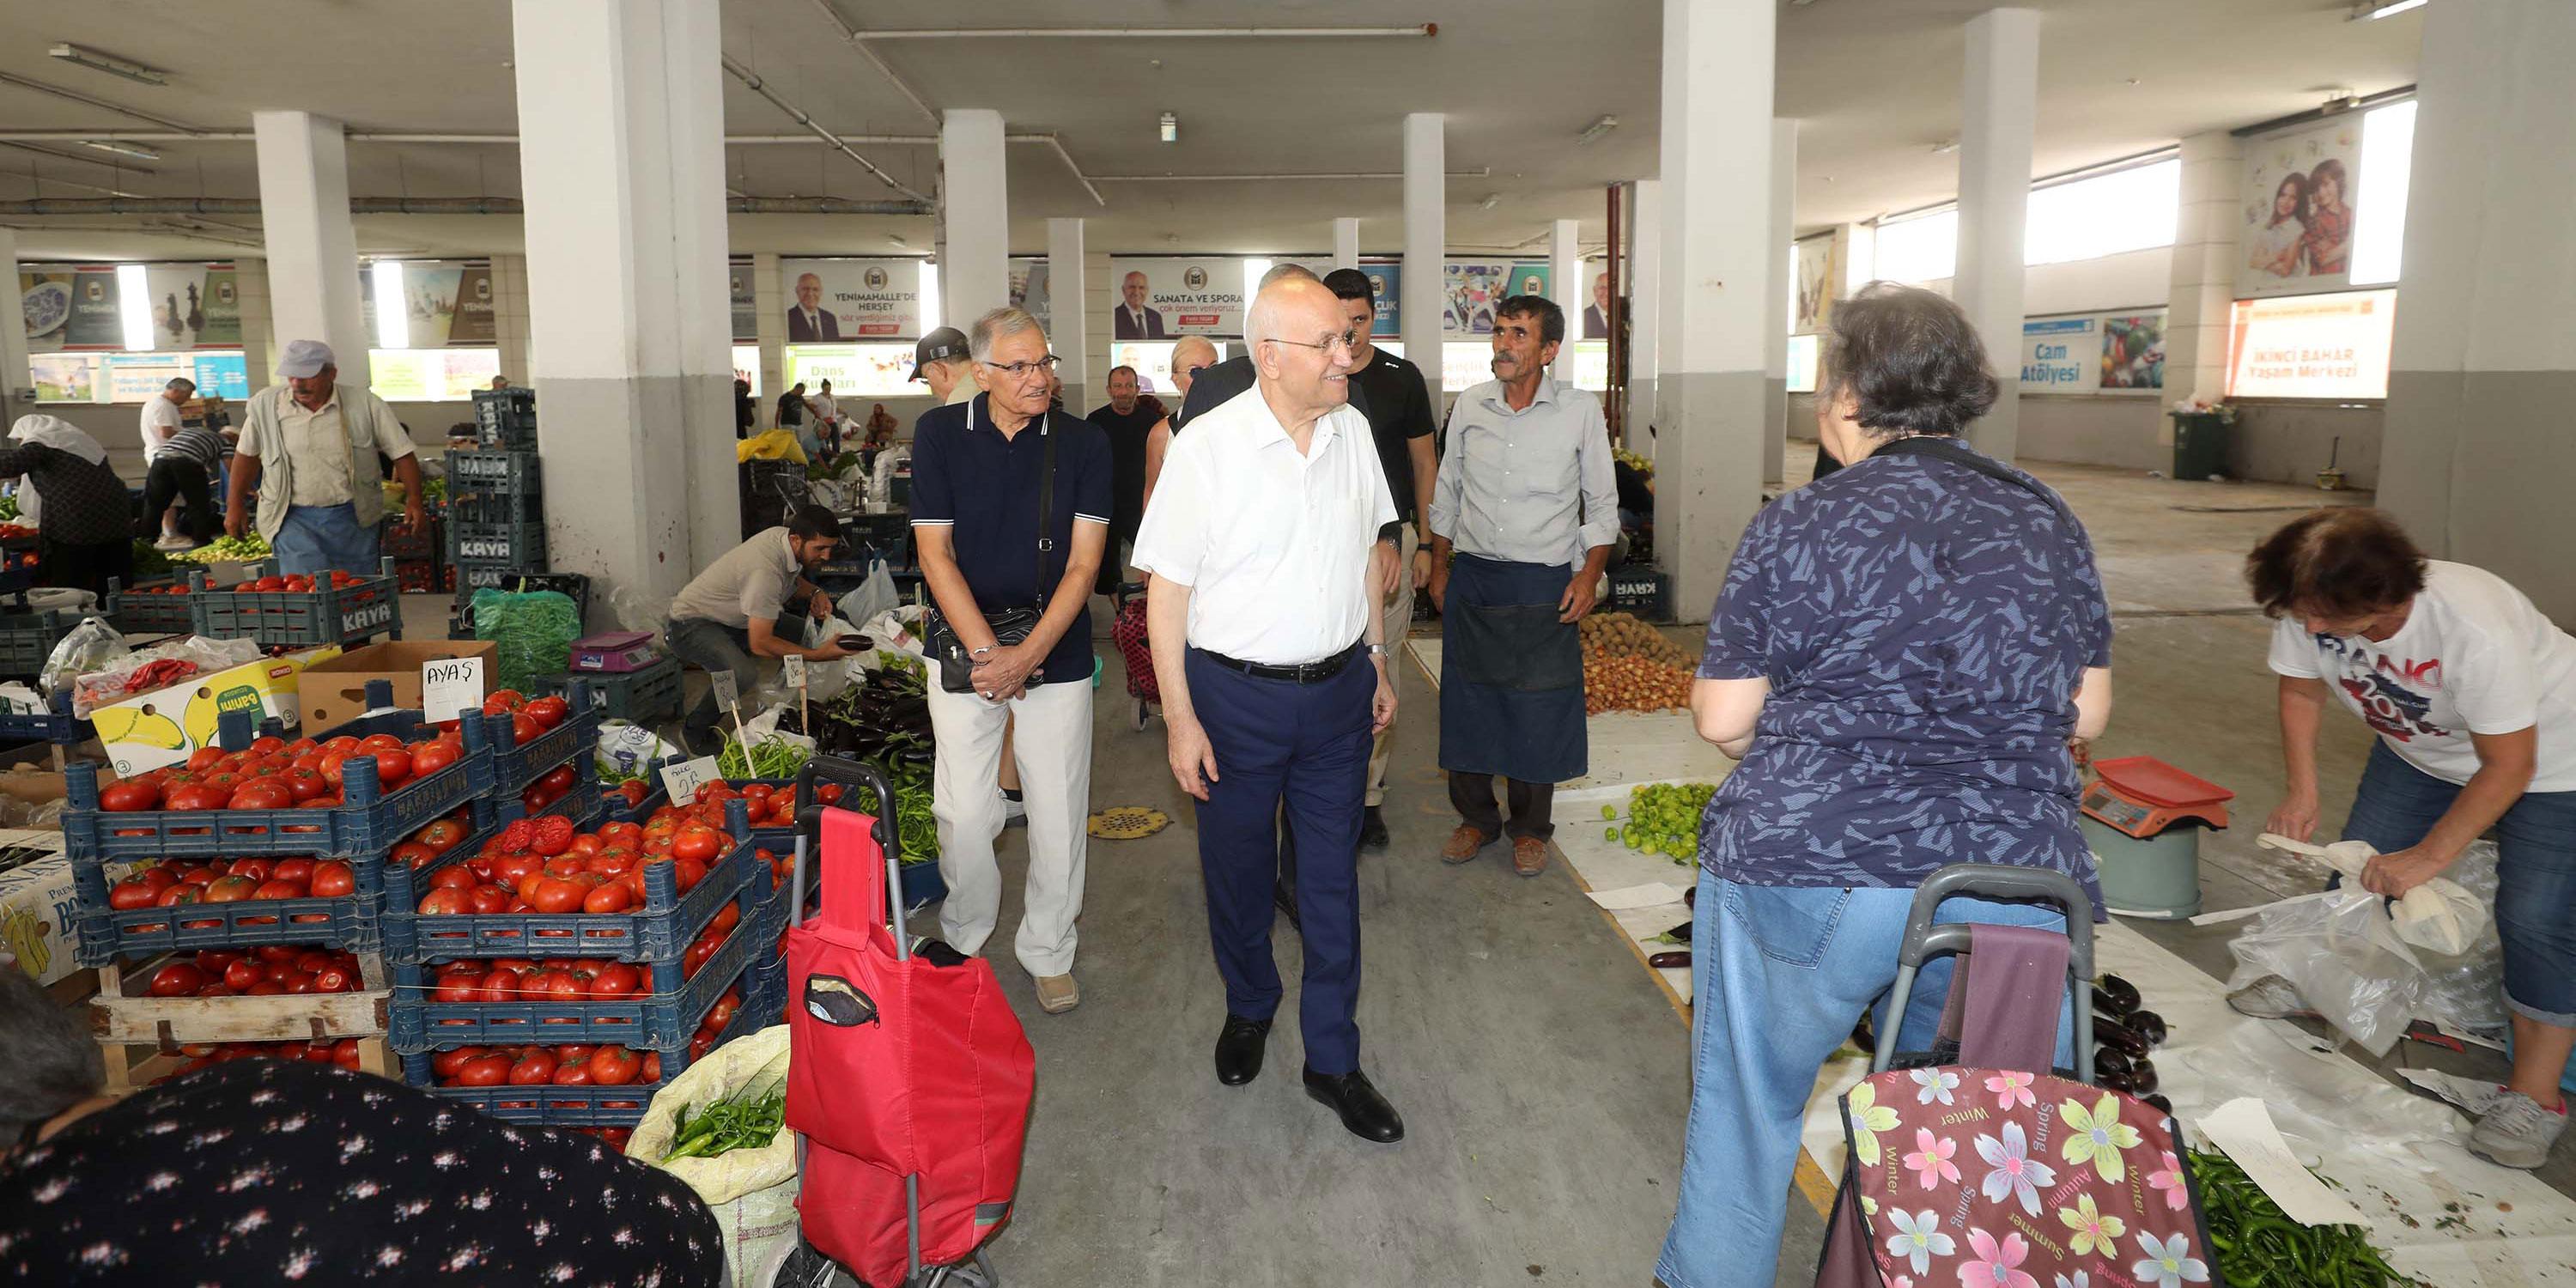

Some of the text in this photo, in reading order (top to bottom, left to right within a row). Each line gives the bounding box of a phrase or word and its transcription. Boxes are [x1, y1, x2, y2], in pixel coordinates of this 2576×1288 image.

[835, 292, 917, 301] YENİMAHALLE'DE
[858, 302, 894, 312] HERŞEY
[1154, 295, 1243, 303] SANATA VE SPORA
[2034, 343, 2067, 361] Cam
[2254, 347, 2354, 362] İKİNCİ BAHAR
[811, 366, 846, 377] Dans
[2020, 362, 2080, 385] Atölyesi
[2248, 362, 2357, 380] Yaşam Merkezi
[459, 541, 510, 556] KAYA
[1615, 582, 1656, 595] KAYA
[342, 604, 392, 632] KAYA
[428, 661, 474, 684] AYAŞ
[1941, 1106, 1990, 1127] Winter
[2032, 1102, 2055, 1153] Spring
[1884, 1146, 1901, 1195] Winter
[2048, 1169, 2093, 1209] Autumn
[2128, 1163, 2144, 1216] Winter
[1950, 1185, 1977, 1229] Spring
[2008, 1212, 2065, 1261] Summer
